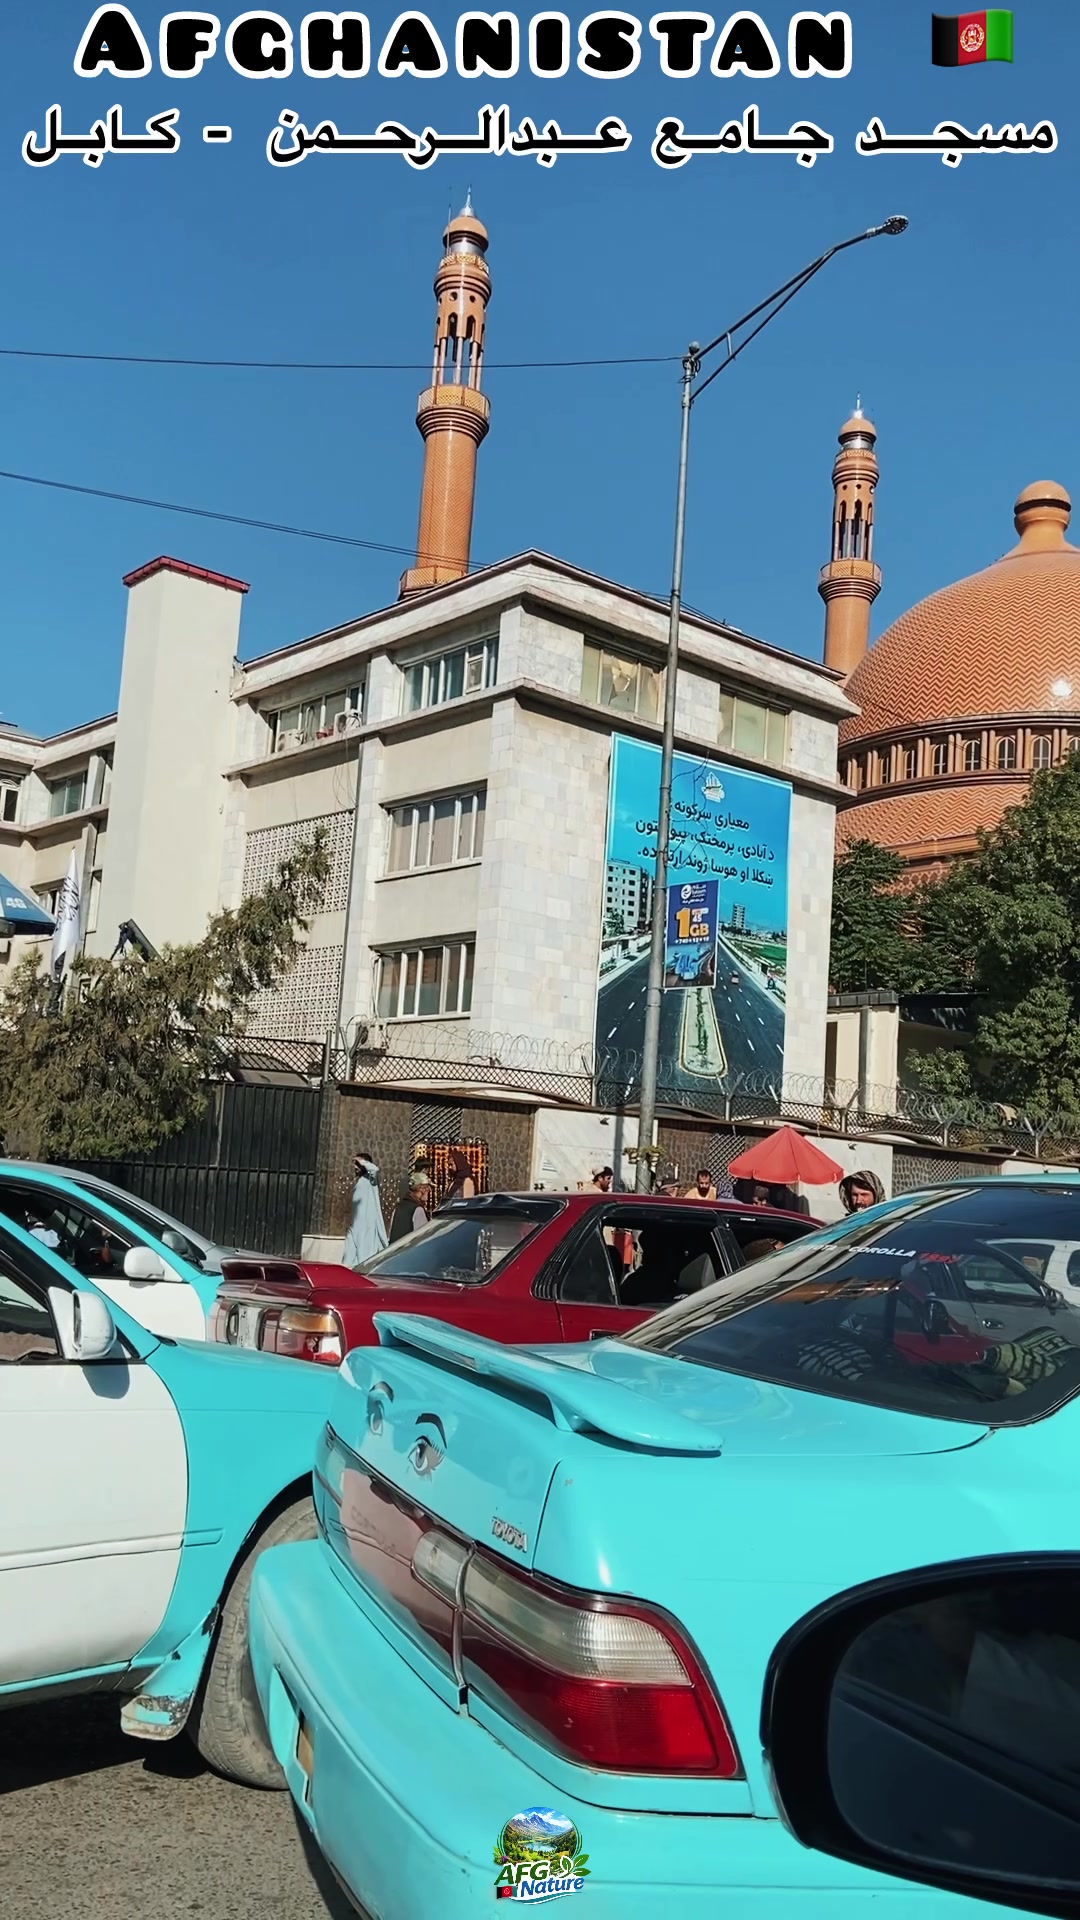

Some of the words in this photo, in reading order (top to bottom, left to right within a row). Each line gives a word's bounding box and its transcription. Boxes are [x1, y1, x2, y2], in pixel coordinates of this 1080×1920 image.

[690, 923, 709, 937] GB
[849, 1244, 917, 1258] COROLLA
[491, 1516, 528, 1553] TOYOTA
